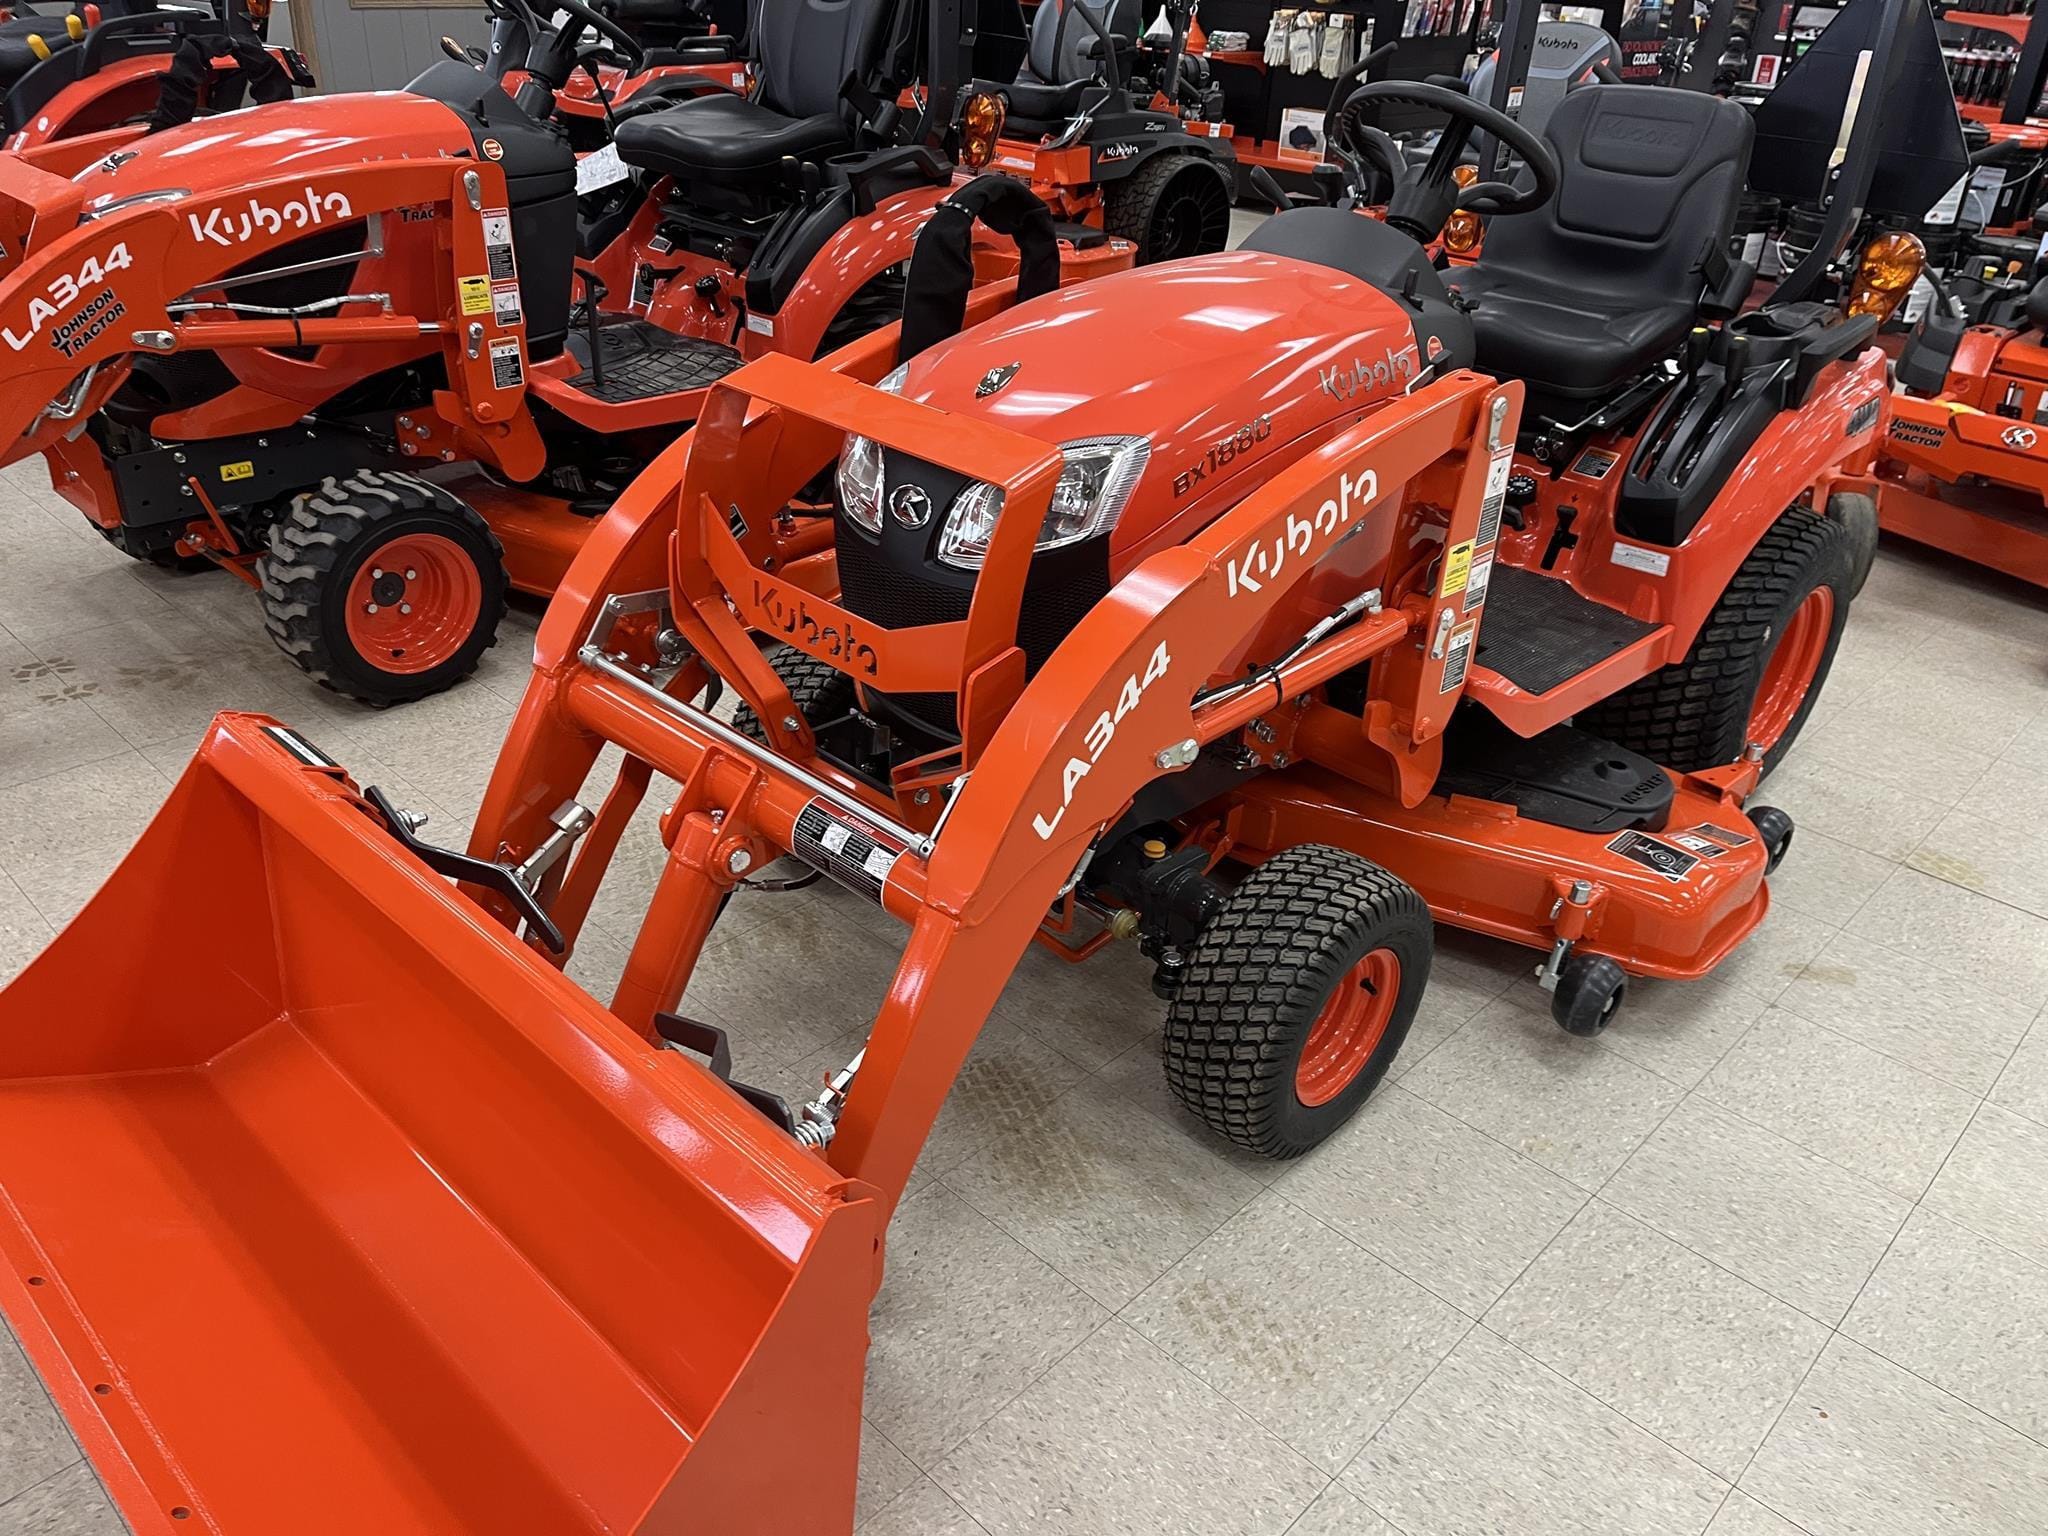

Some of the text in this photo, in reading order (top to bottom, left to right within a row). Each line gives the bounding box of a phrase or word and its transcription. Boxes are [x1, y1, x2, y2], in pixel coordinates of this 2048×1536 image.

[1538, 37, 1578, 50] Kubota
[1107, 144, 1139, 156] Kubota
[188, 187, 352, 246] Kubota
[400, 208, 434, 222] TRAC
[1, 242, 133, 351] LA344
[51, 288, 114, 348] JOHNSON
[59, 303, 125, 358] TRACTOR
[1319, 347, 1412, 400] Kubota
[1888, 428, 1941, 448] TRACTOR
[1890, 417, 1946, 437] JOHNSON
[1173, 413, 1272, 498] BX1880
[1227, 469, 1377, 598] Kubota
[754, 580, 877, 676] Kubota
[1032, 640, 1171, 840] LA344
[849, 816, 876, 835] DANGER
